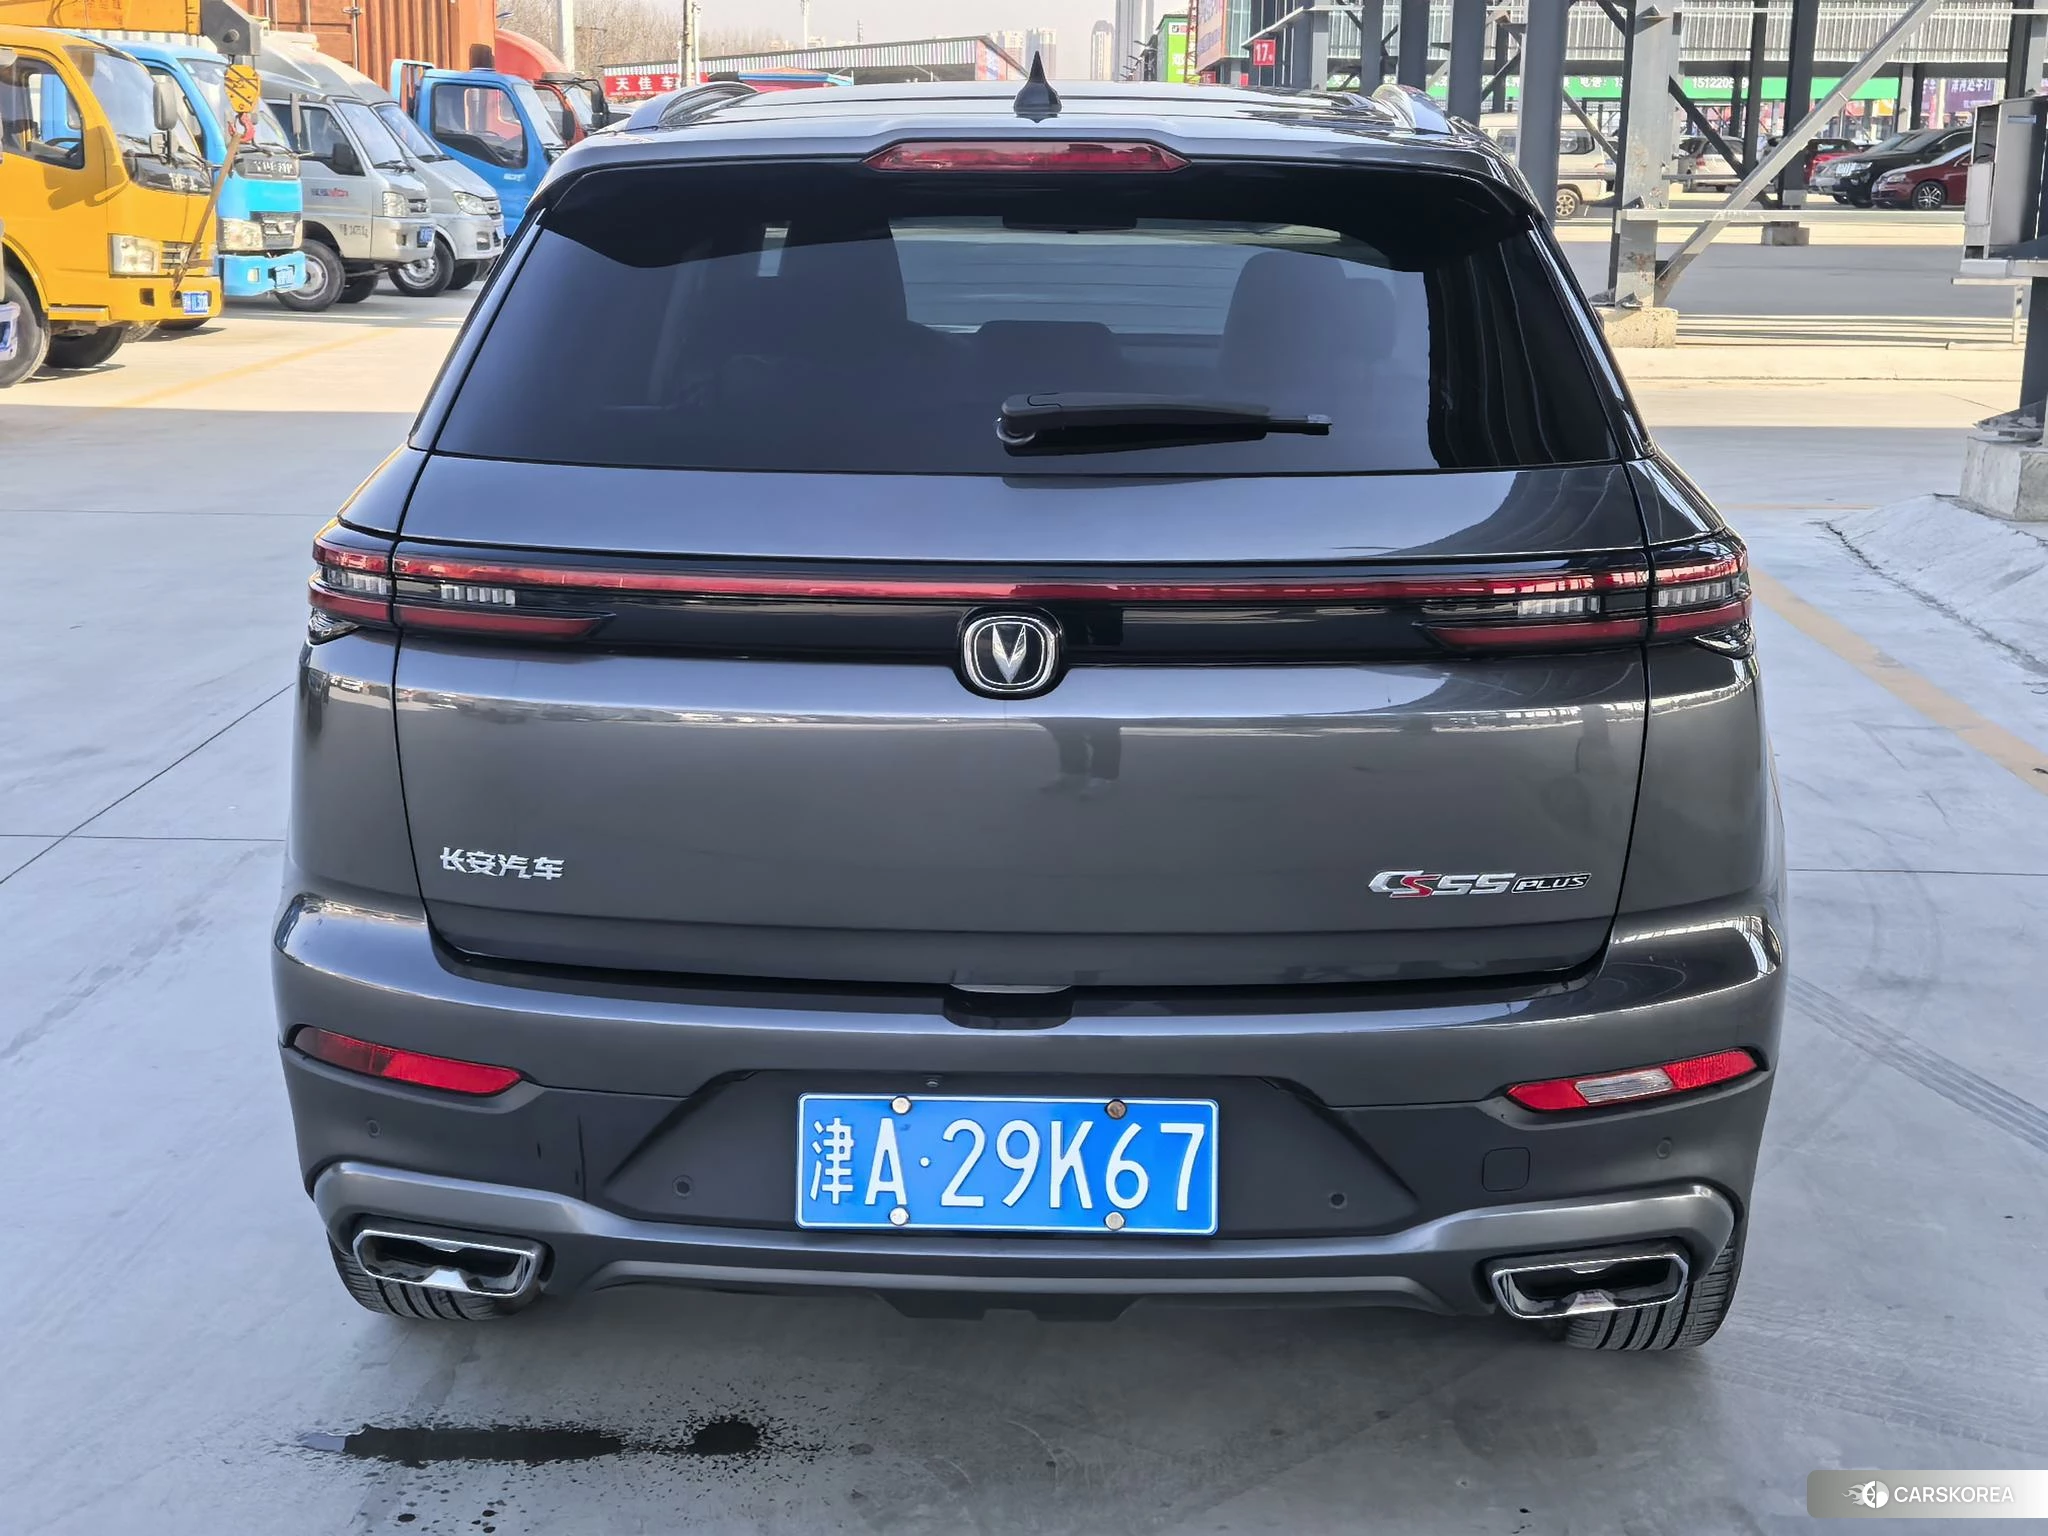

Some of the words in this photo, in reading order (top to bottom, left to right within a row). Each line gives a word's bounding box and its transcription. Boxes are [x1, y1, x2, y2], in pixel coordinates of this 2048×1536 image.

[440, 847, 564, 880] 长安汽车
[1368, 870, 1517, 898] CS55
[1518, 874, 1588, 891] PLUS
